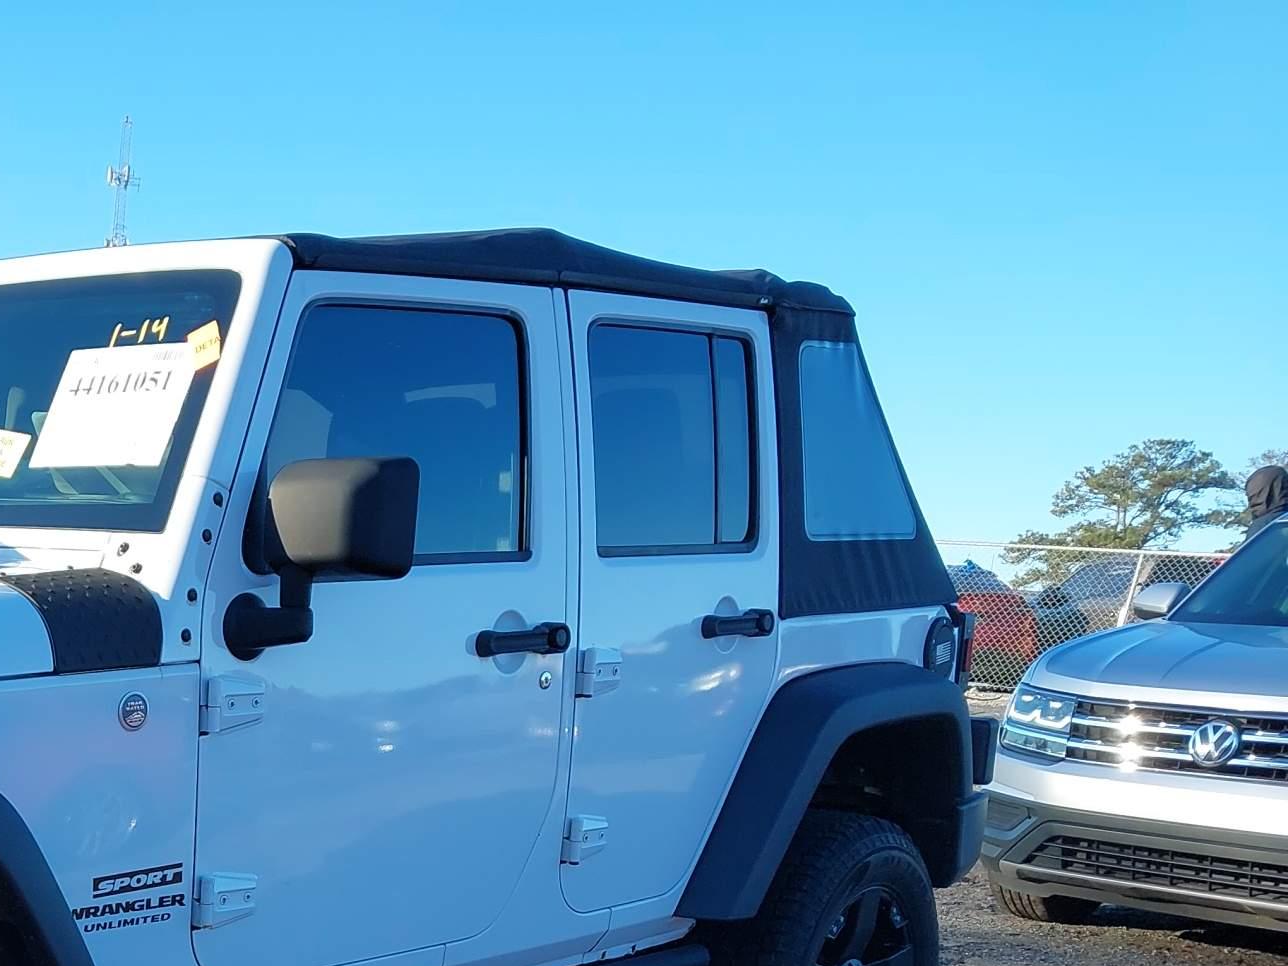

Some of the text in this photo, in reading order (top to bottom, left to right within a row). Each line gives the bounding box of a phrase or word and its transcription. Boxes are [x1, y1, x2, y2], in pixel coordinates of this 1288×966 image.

[69, 370, 173, 396] 44161051
[94, 866, 183, 895] SPORT
[72, 894, 186, 921] WRANGLER
[83, 912, 171, 933] UNLIMITED
